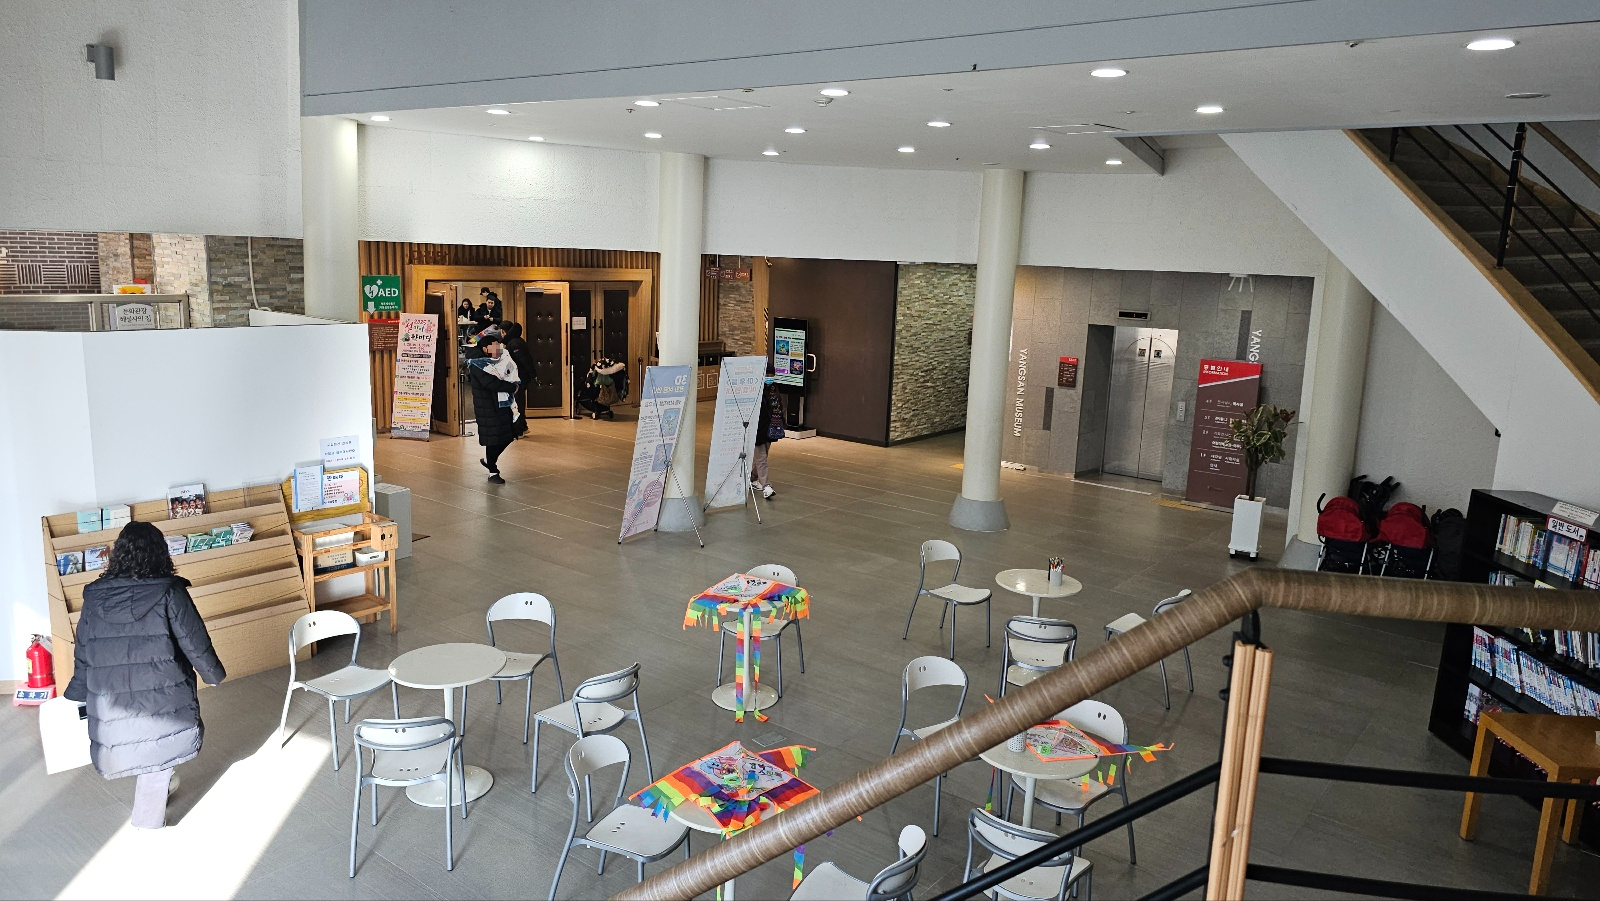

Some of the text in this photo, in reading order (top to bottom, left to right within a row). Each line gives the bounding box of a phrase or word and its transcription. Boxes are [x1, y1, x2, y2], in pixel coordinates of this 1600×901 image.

[378, 287, 399, 297] AED
[120, 315, 143, 323] 해설사의
[1249, 329, 1262, 364] YANG
[1013, 348, 1028, 437] YANGSAN MUSEUM
[176, 507, 203, 519] 2025
[1552, 520, 1580, 537] 일반 도서
[17, 691, 49, 700] 소화기
